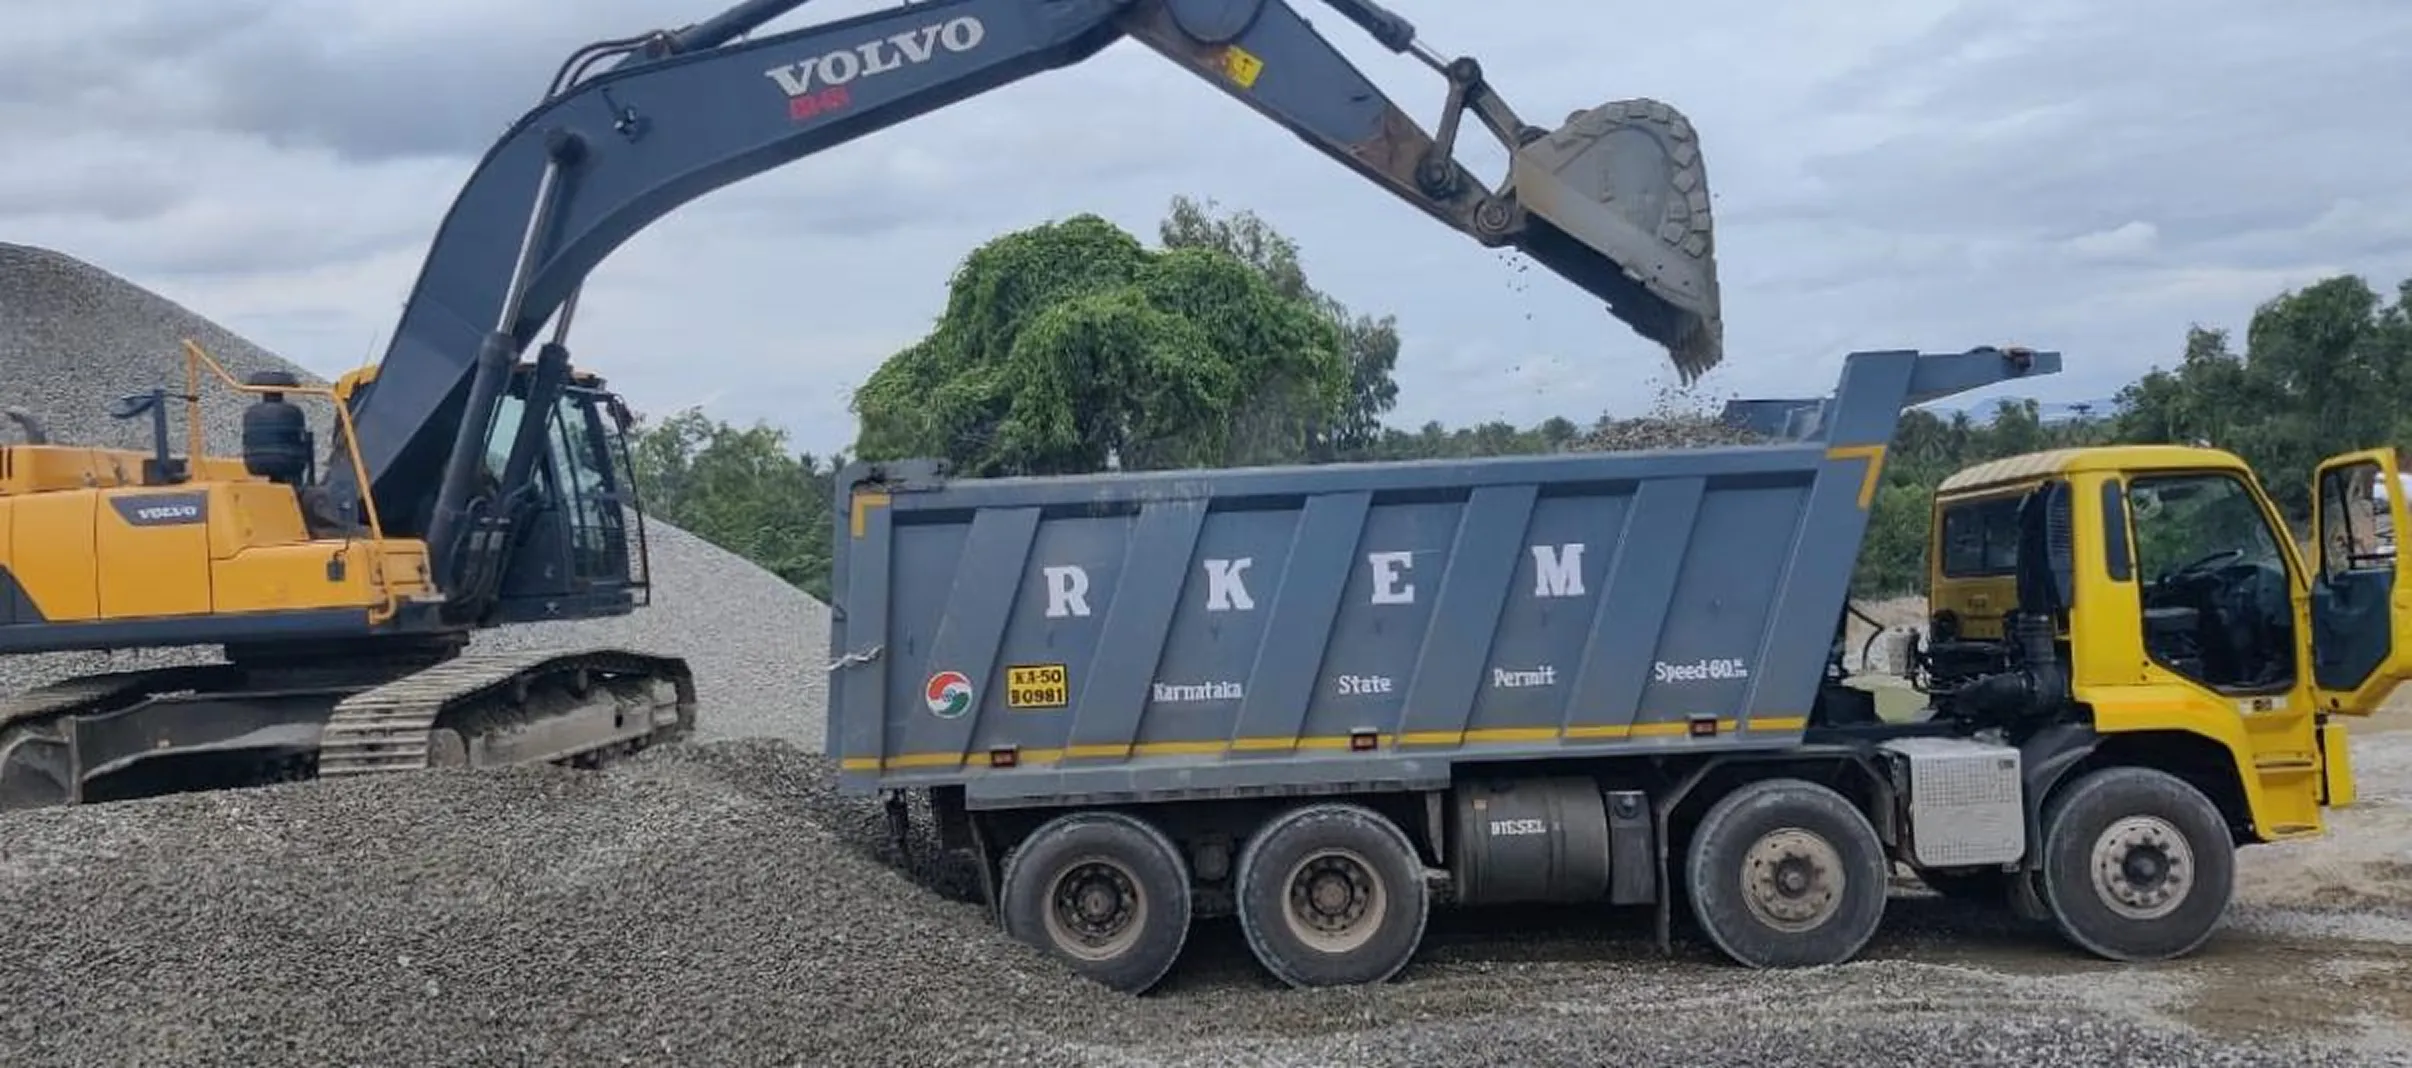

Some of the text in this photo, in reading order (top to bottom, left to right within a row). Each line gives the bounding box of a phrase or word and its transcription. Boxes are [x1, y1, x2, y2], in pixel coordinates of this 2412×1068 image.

[764, 16, 985, 97] VOLVO
[137, 506, 197, 519] VOLVO
[1043, 543, 1585, 617] R K E M
[1014, 670, 1062, 685] KA-50
[1153, 681, 1243, 702] Karnataka
[1338, 675, 1393, 695] State
[1493, 666, 1557, 688] Permit
[1490, 819, 1547, 836] DIESEL
